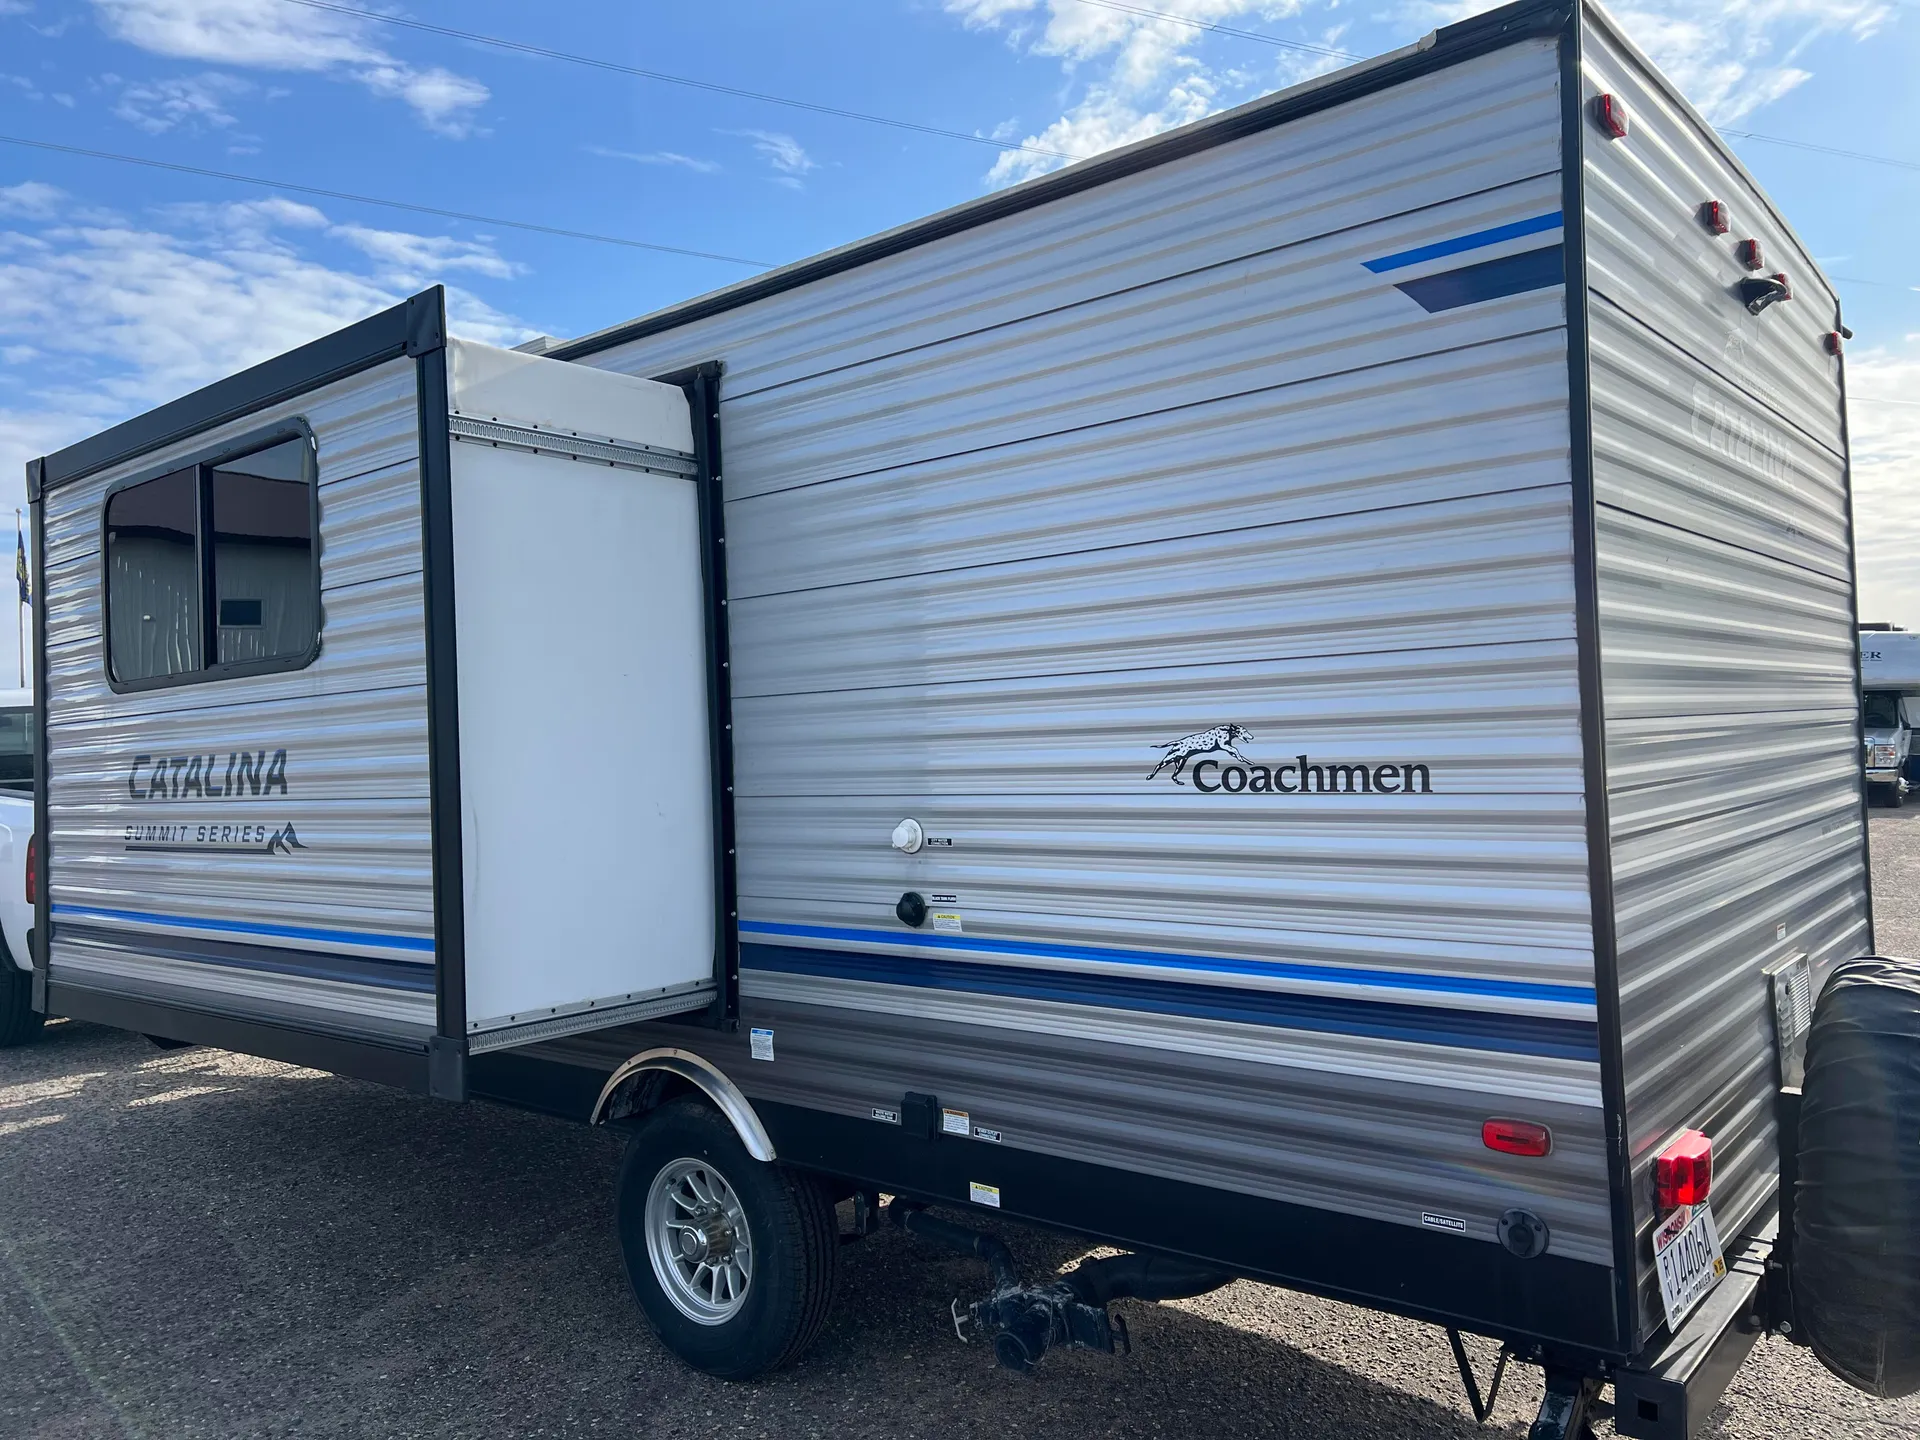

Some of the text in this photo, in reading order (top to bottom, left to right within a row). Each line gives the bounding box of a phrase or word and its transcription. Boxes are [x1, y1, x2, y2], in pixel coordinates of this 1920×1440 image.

[128, 748, 289, 799] CATALINA
[1192, 755, 1433, 793] Coachmen
[124, 825, 266, 843] SUMMIT SERIES
[1424, 1215, 1464, 1229] CABLE/SATELLITE
